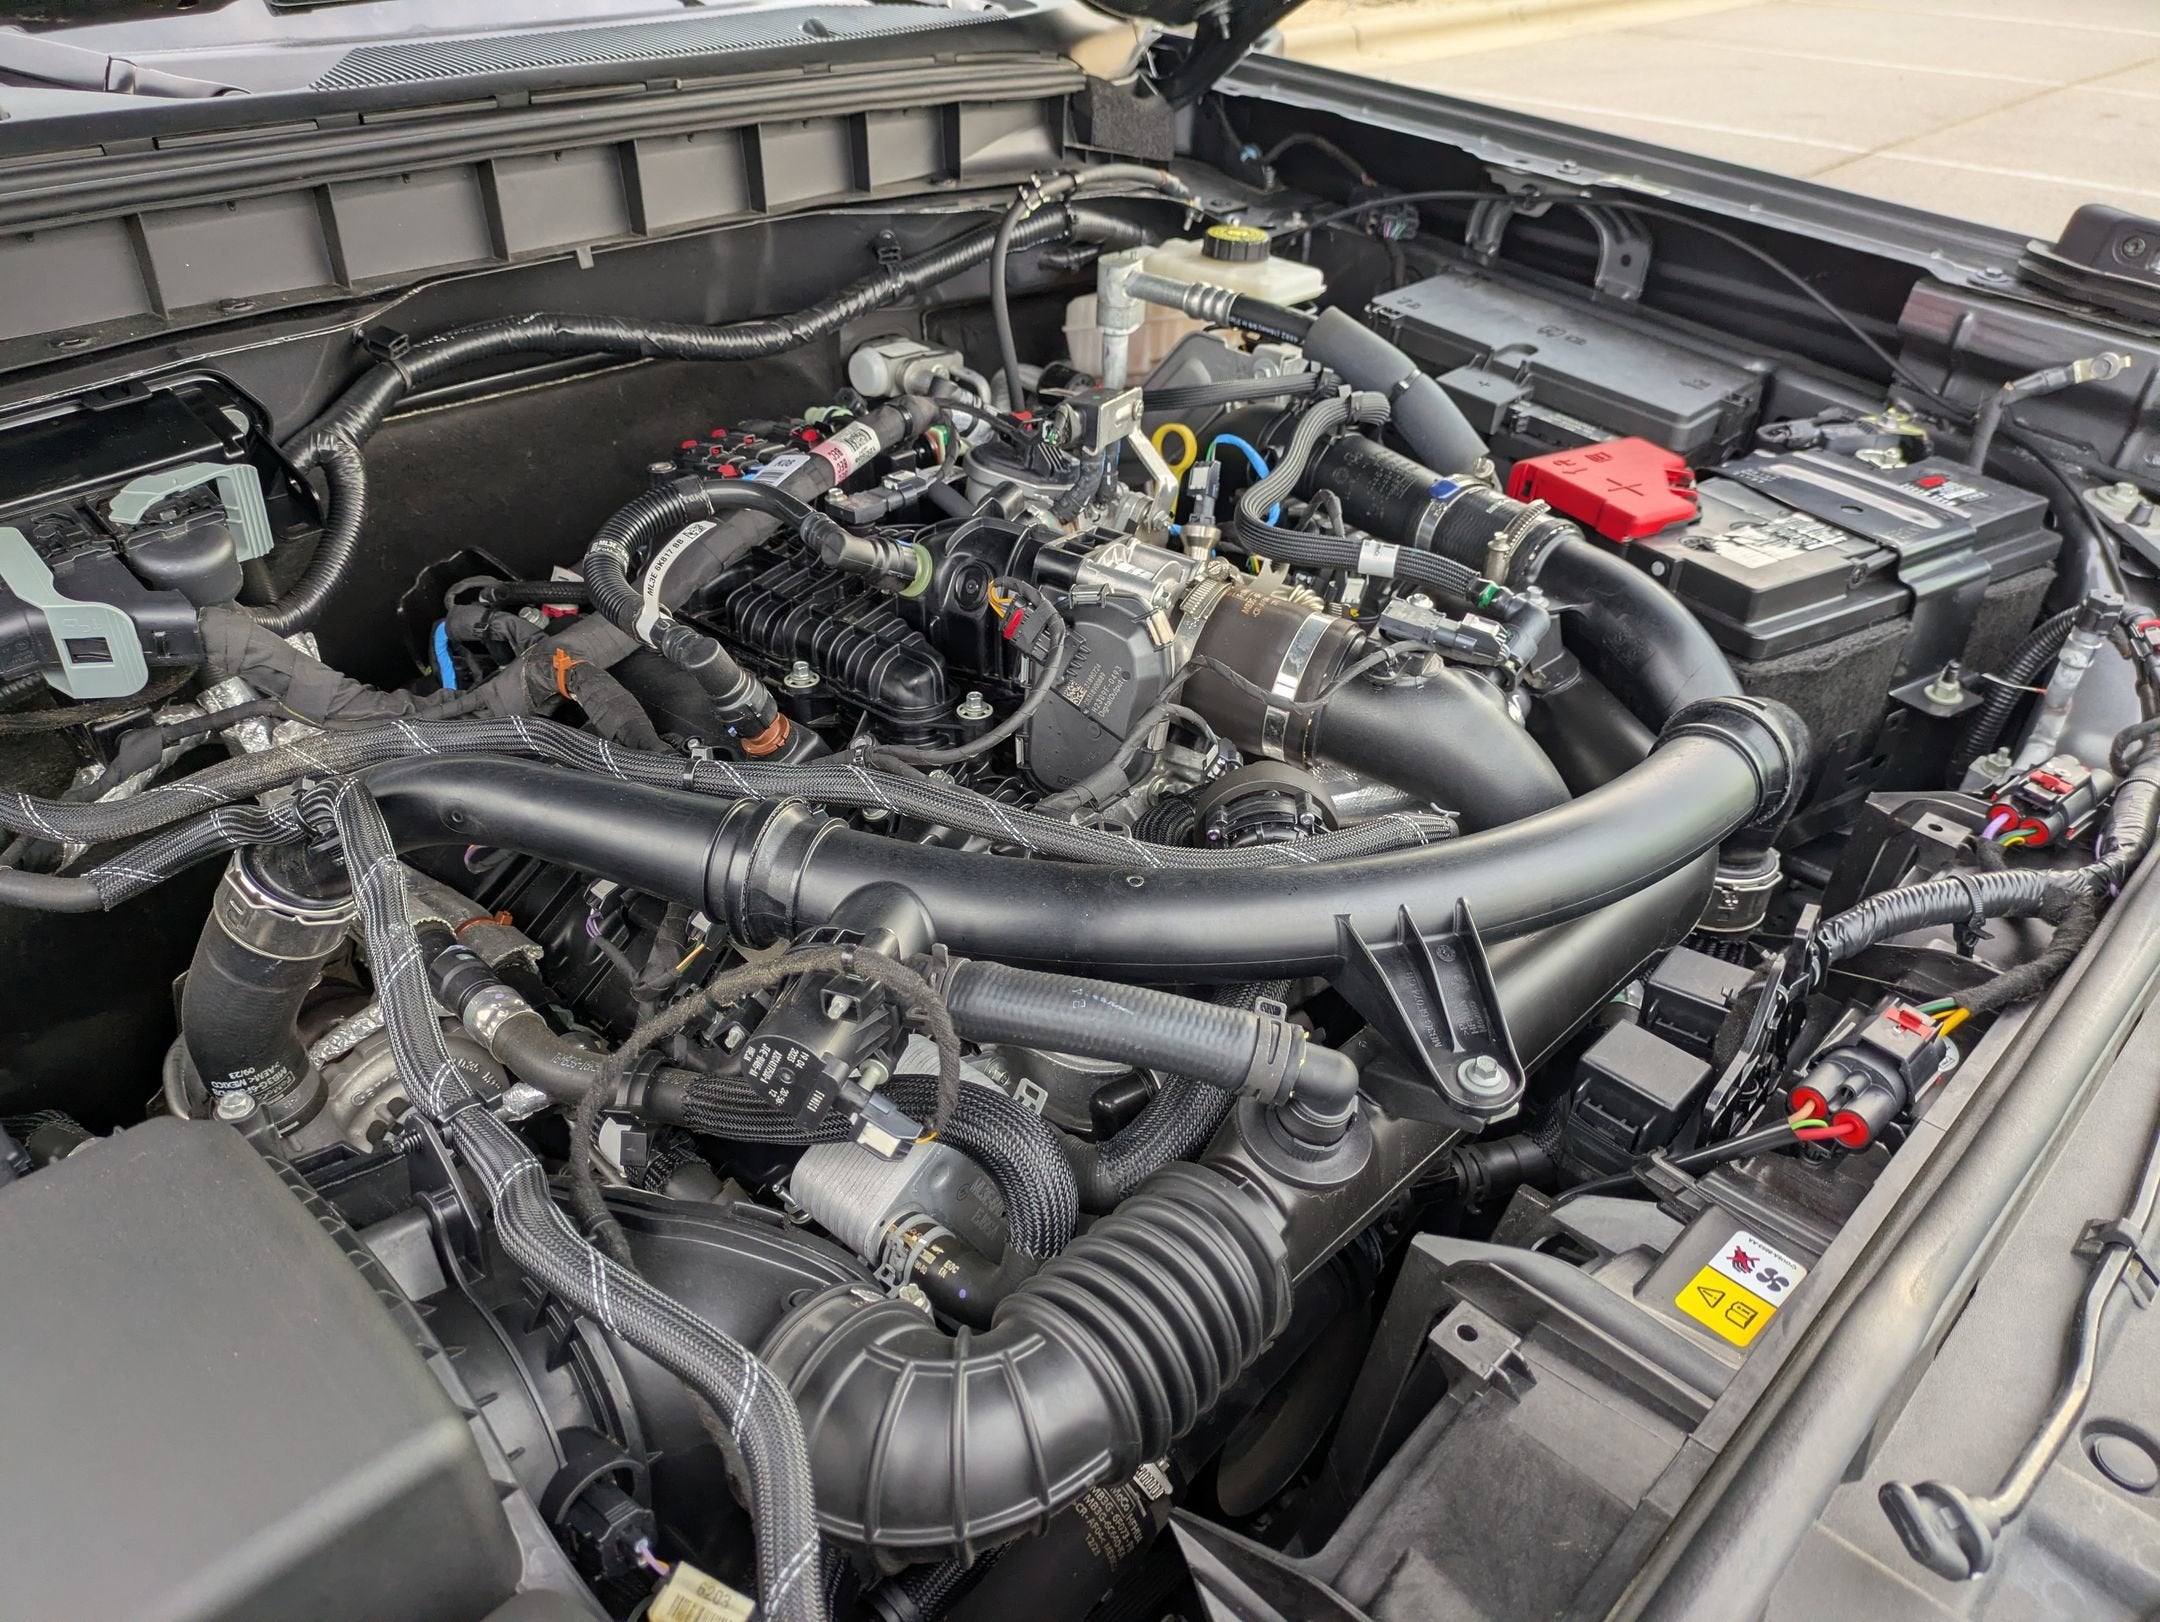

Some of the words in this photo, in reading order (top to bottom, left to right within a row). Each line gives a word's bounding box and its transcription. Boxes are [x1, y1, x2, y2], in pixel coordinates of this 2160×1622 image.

[647, 572, 658, 596] ML3E
[654, 548, 674, 571] 6K817
[228, 1067, 256, 1080] 09/23
[696, 1582, 732, 1608] 6203
